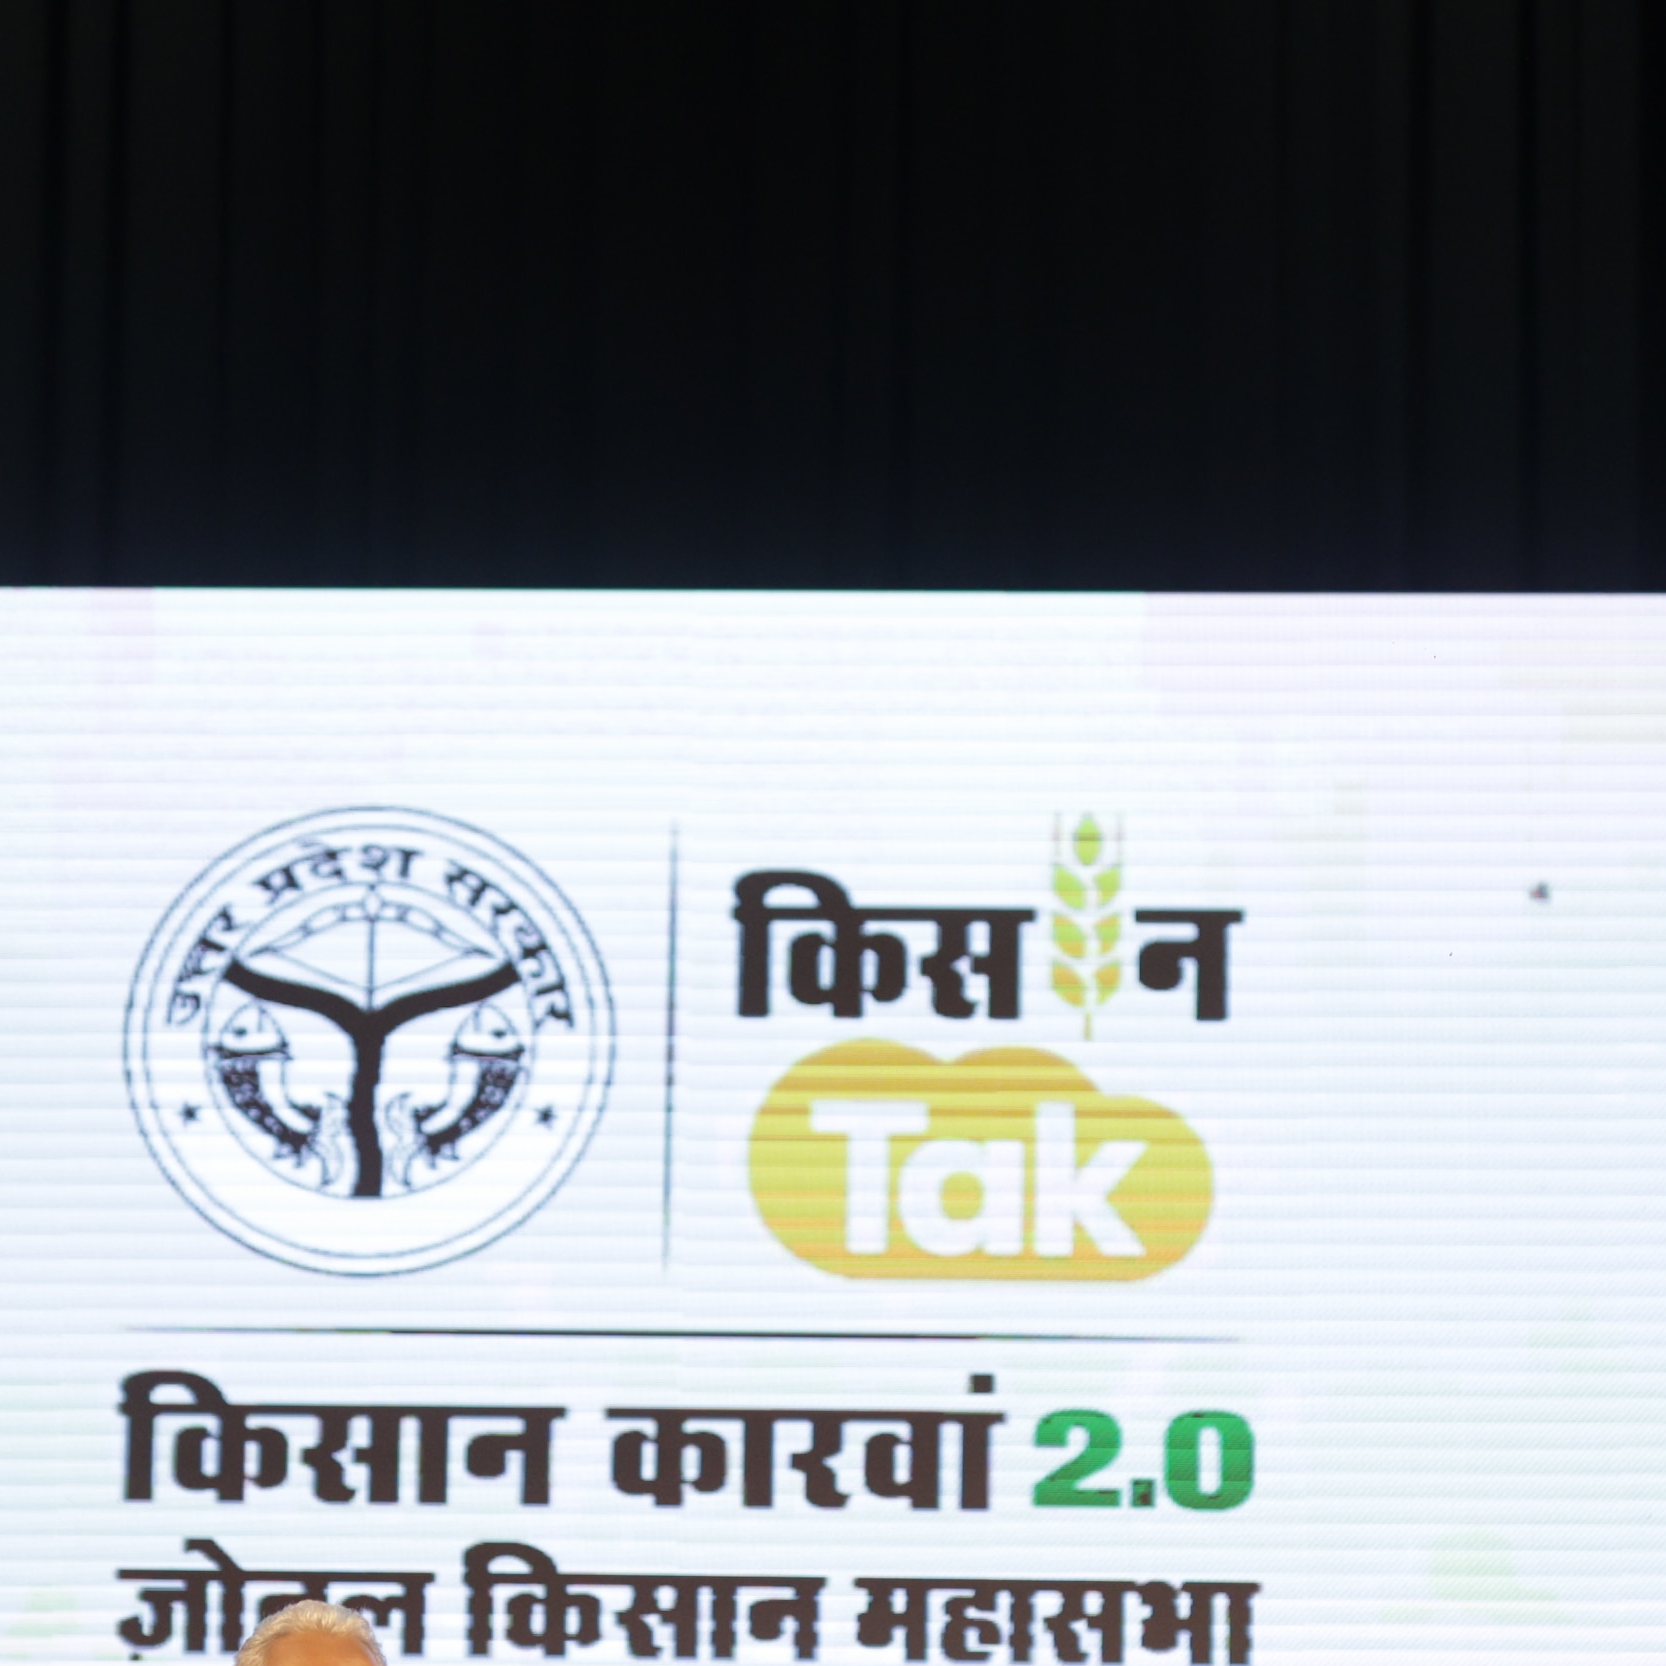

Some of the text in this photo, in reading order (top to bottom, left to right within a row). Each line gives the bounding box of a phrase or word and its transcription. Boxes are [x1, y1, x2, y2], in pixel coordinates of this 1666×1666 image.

[165, 837, 576, 1032] उत्तर प्रदेश सरकार
[809, 1097, 1147, 1260] Tak
[119, 1370, 1255, 1510] किसान कारवां 2.0
[466, 1542, 825, 1657] किसान
[856, 1576, 1260, 1666] महासभा
